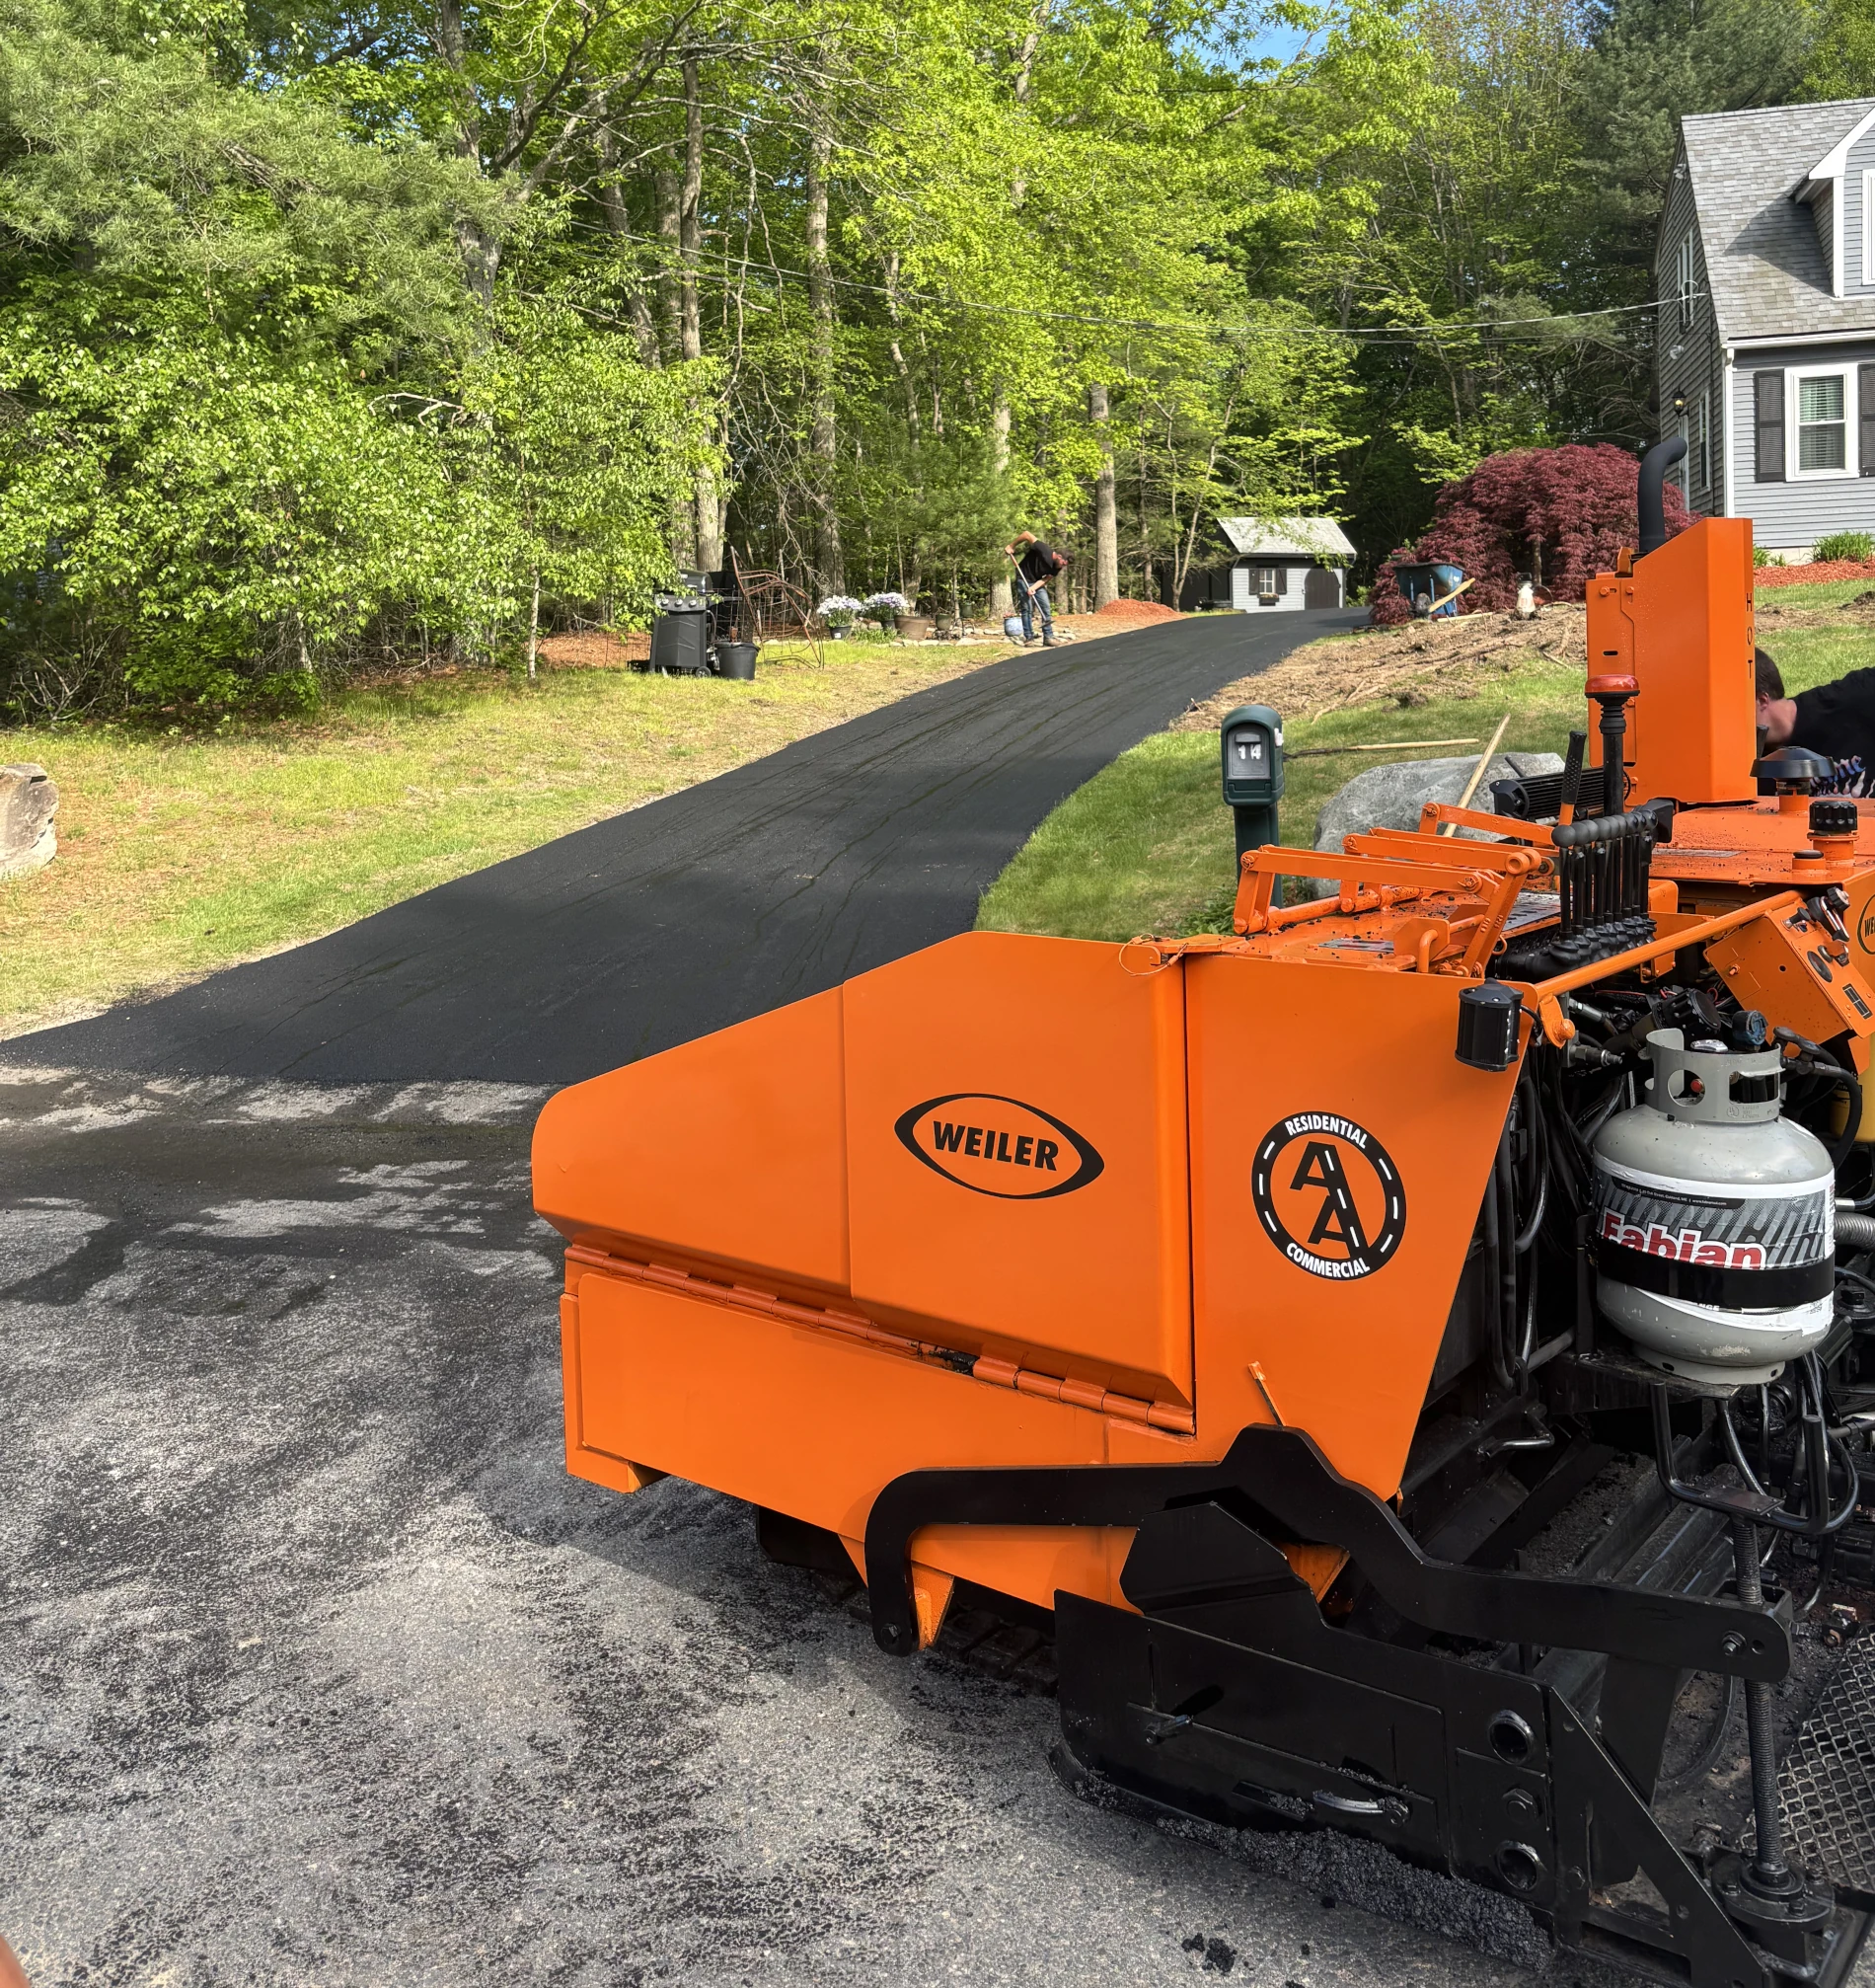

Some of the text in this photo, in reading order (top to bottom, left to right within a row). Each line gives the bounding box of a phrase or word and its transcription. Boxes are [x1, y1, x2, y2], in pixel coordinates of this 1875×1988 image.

[1238, 743, 1262, 760] 14
[933, 1120, 1059, 1172] WEILER
[1285, 1114, 1368, 1149] RESIDENTIAL
[1603, 1210, 1764, 1269] Fabian
[1286, 1242, 1371, 1277] COMMERCIAL
